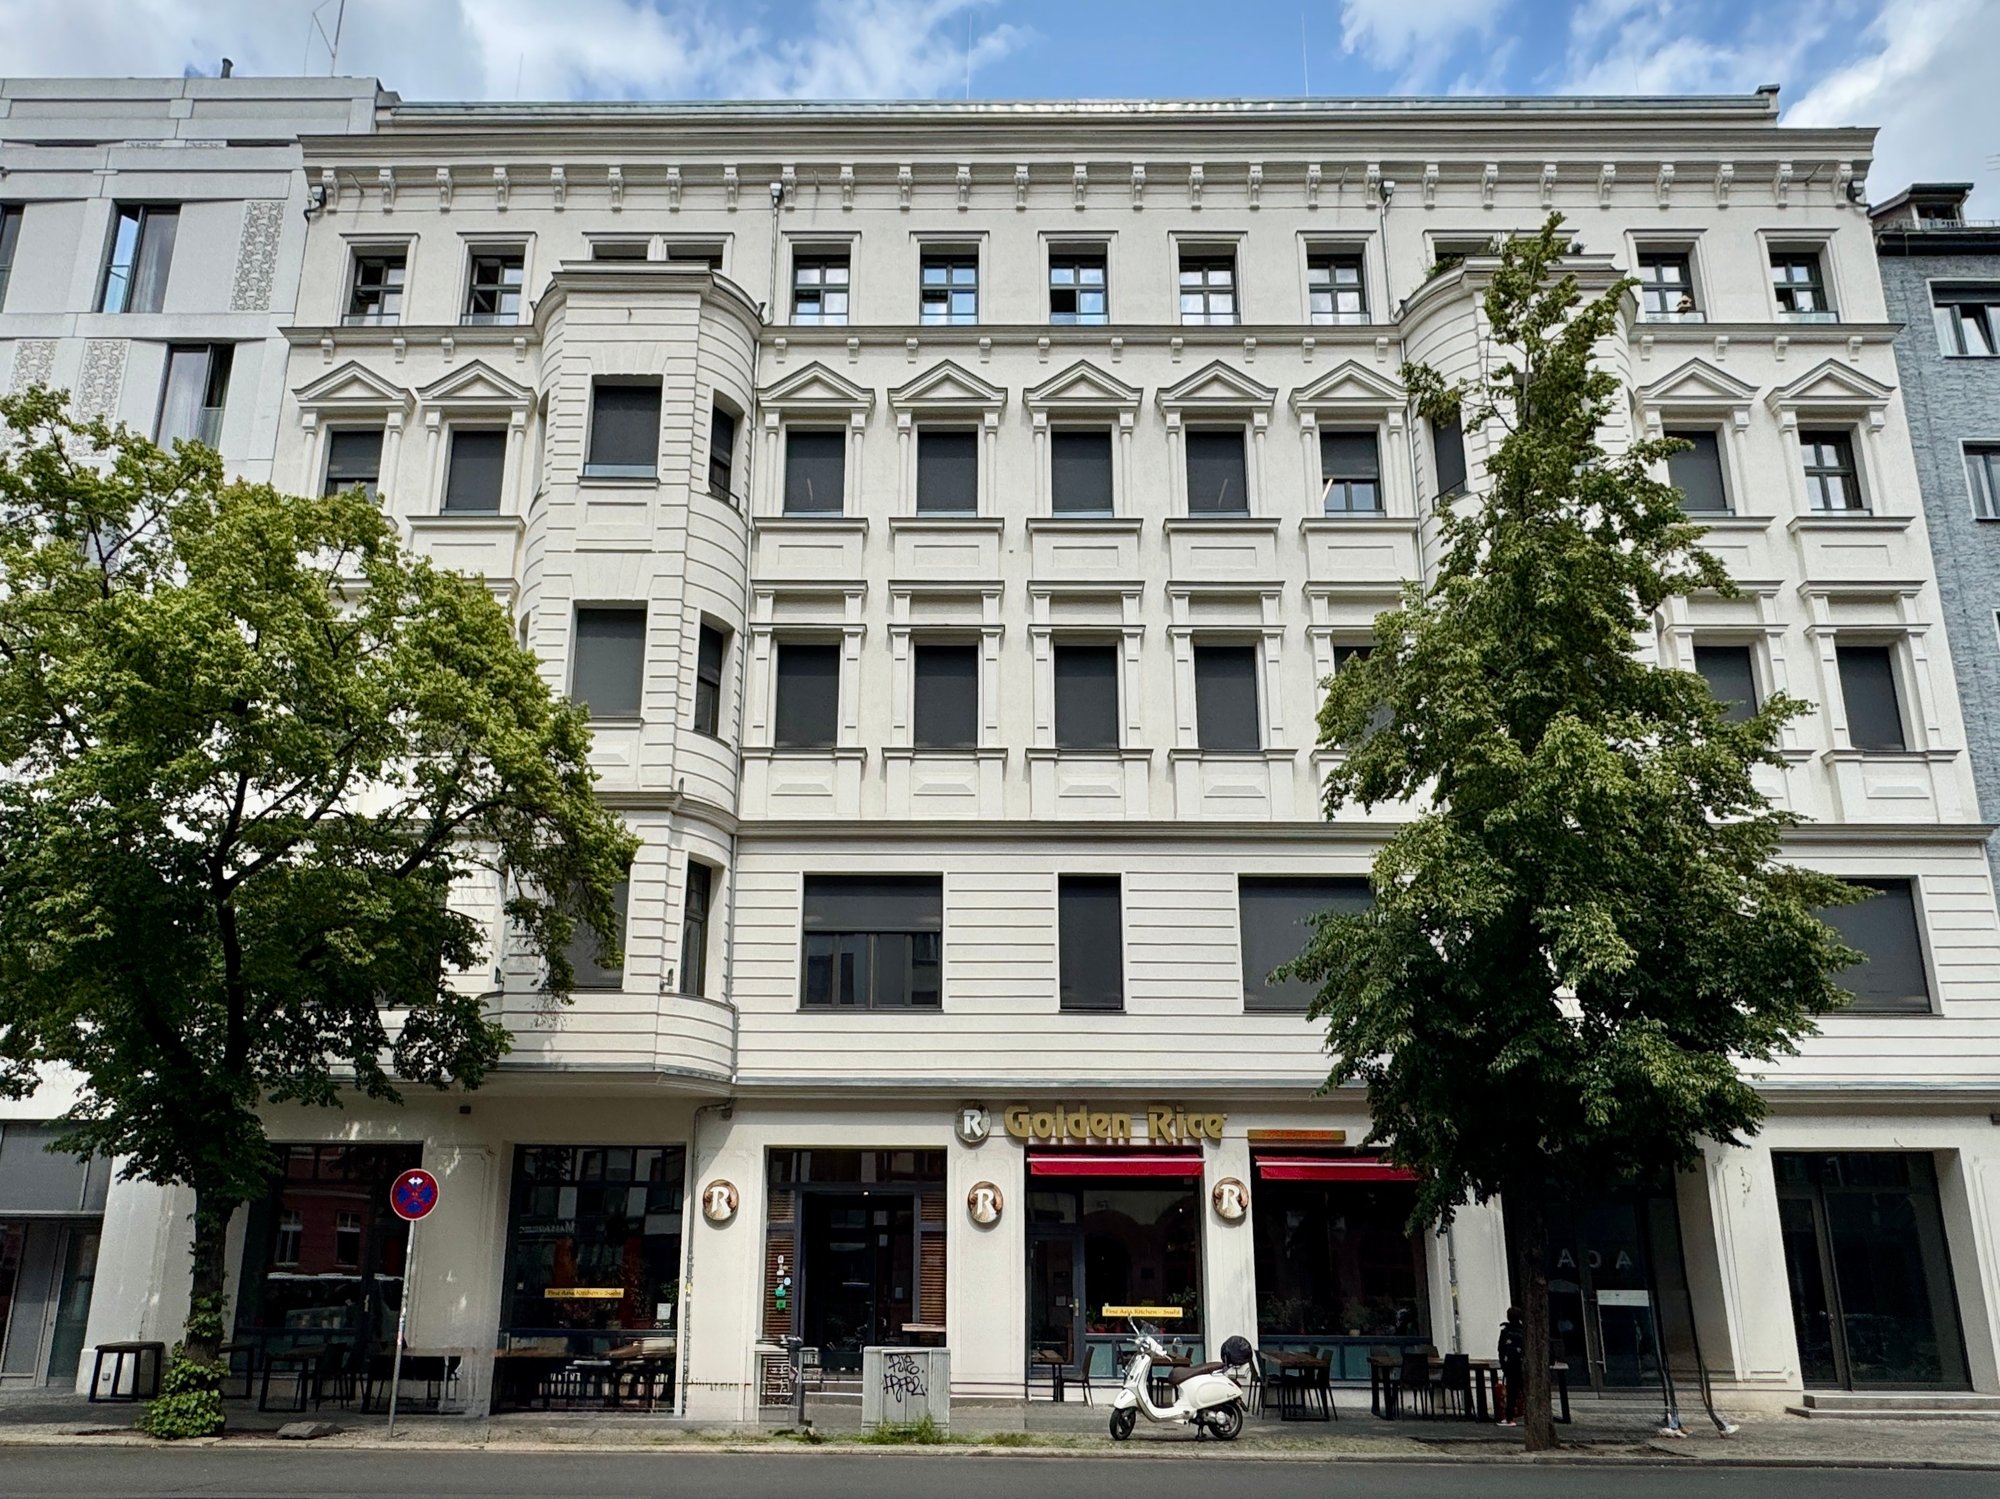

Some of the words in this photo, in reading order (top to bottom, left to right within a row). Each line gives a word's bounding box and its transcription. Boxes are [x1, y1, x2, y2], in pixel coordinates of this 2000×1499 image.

[963, 1109, 984, 1137] R
[1004, 1105, 1131, 1138] Golden
[1147, 1105, 1224, 1143] Rice
[710, 1186, 731, 1217] R
[974, 1188, 997, 1220] R
[1220, 1183, 1242, 1216] R
